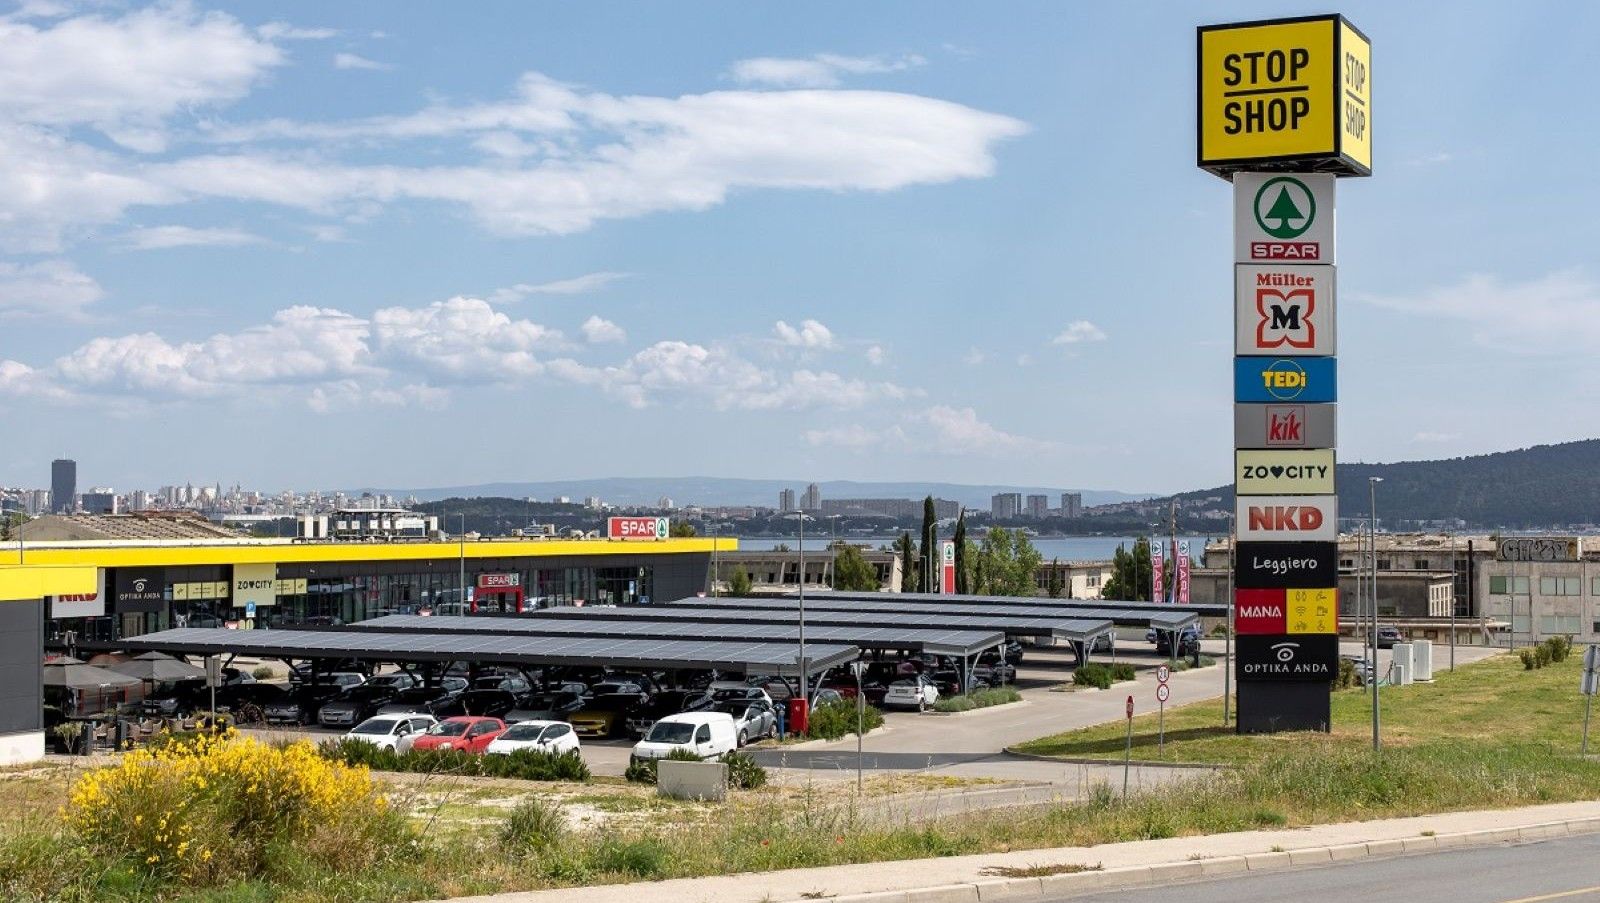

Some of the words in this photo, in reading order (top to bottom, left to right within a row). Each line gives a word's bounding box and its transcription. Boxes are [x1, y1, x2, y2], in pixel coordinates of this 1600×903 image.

[1224, 48, 1310, 86] STOP
[1345, 52, 1366, 94] STOP
[1224, 96, 1310, 135] SHOP
[1345, 101, 1366, 142] SHOP
[1253, 244, 1317, 258] SPAR
[1256, 272, 1314, 286] Müller
[1270, 304, 1301, 329] M
[1262, 371, 1306, 387] TEDi
[1248, 506, 1323, 531] NKD
[620, 520, 655, 535] SPAR
[1253, 556, 1318, 575] Leggiero
[487, 576, 509, 585] SPAR
[1240, 605, 1282, 618] MANA
[1244, 663, 1290, 673] OPTIKA
[1293, 663, 1328, 673] ANDA
